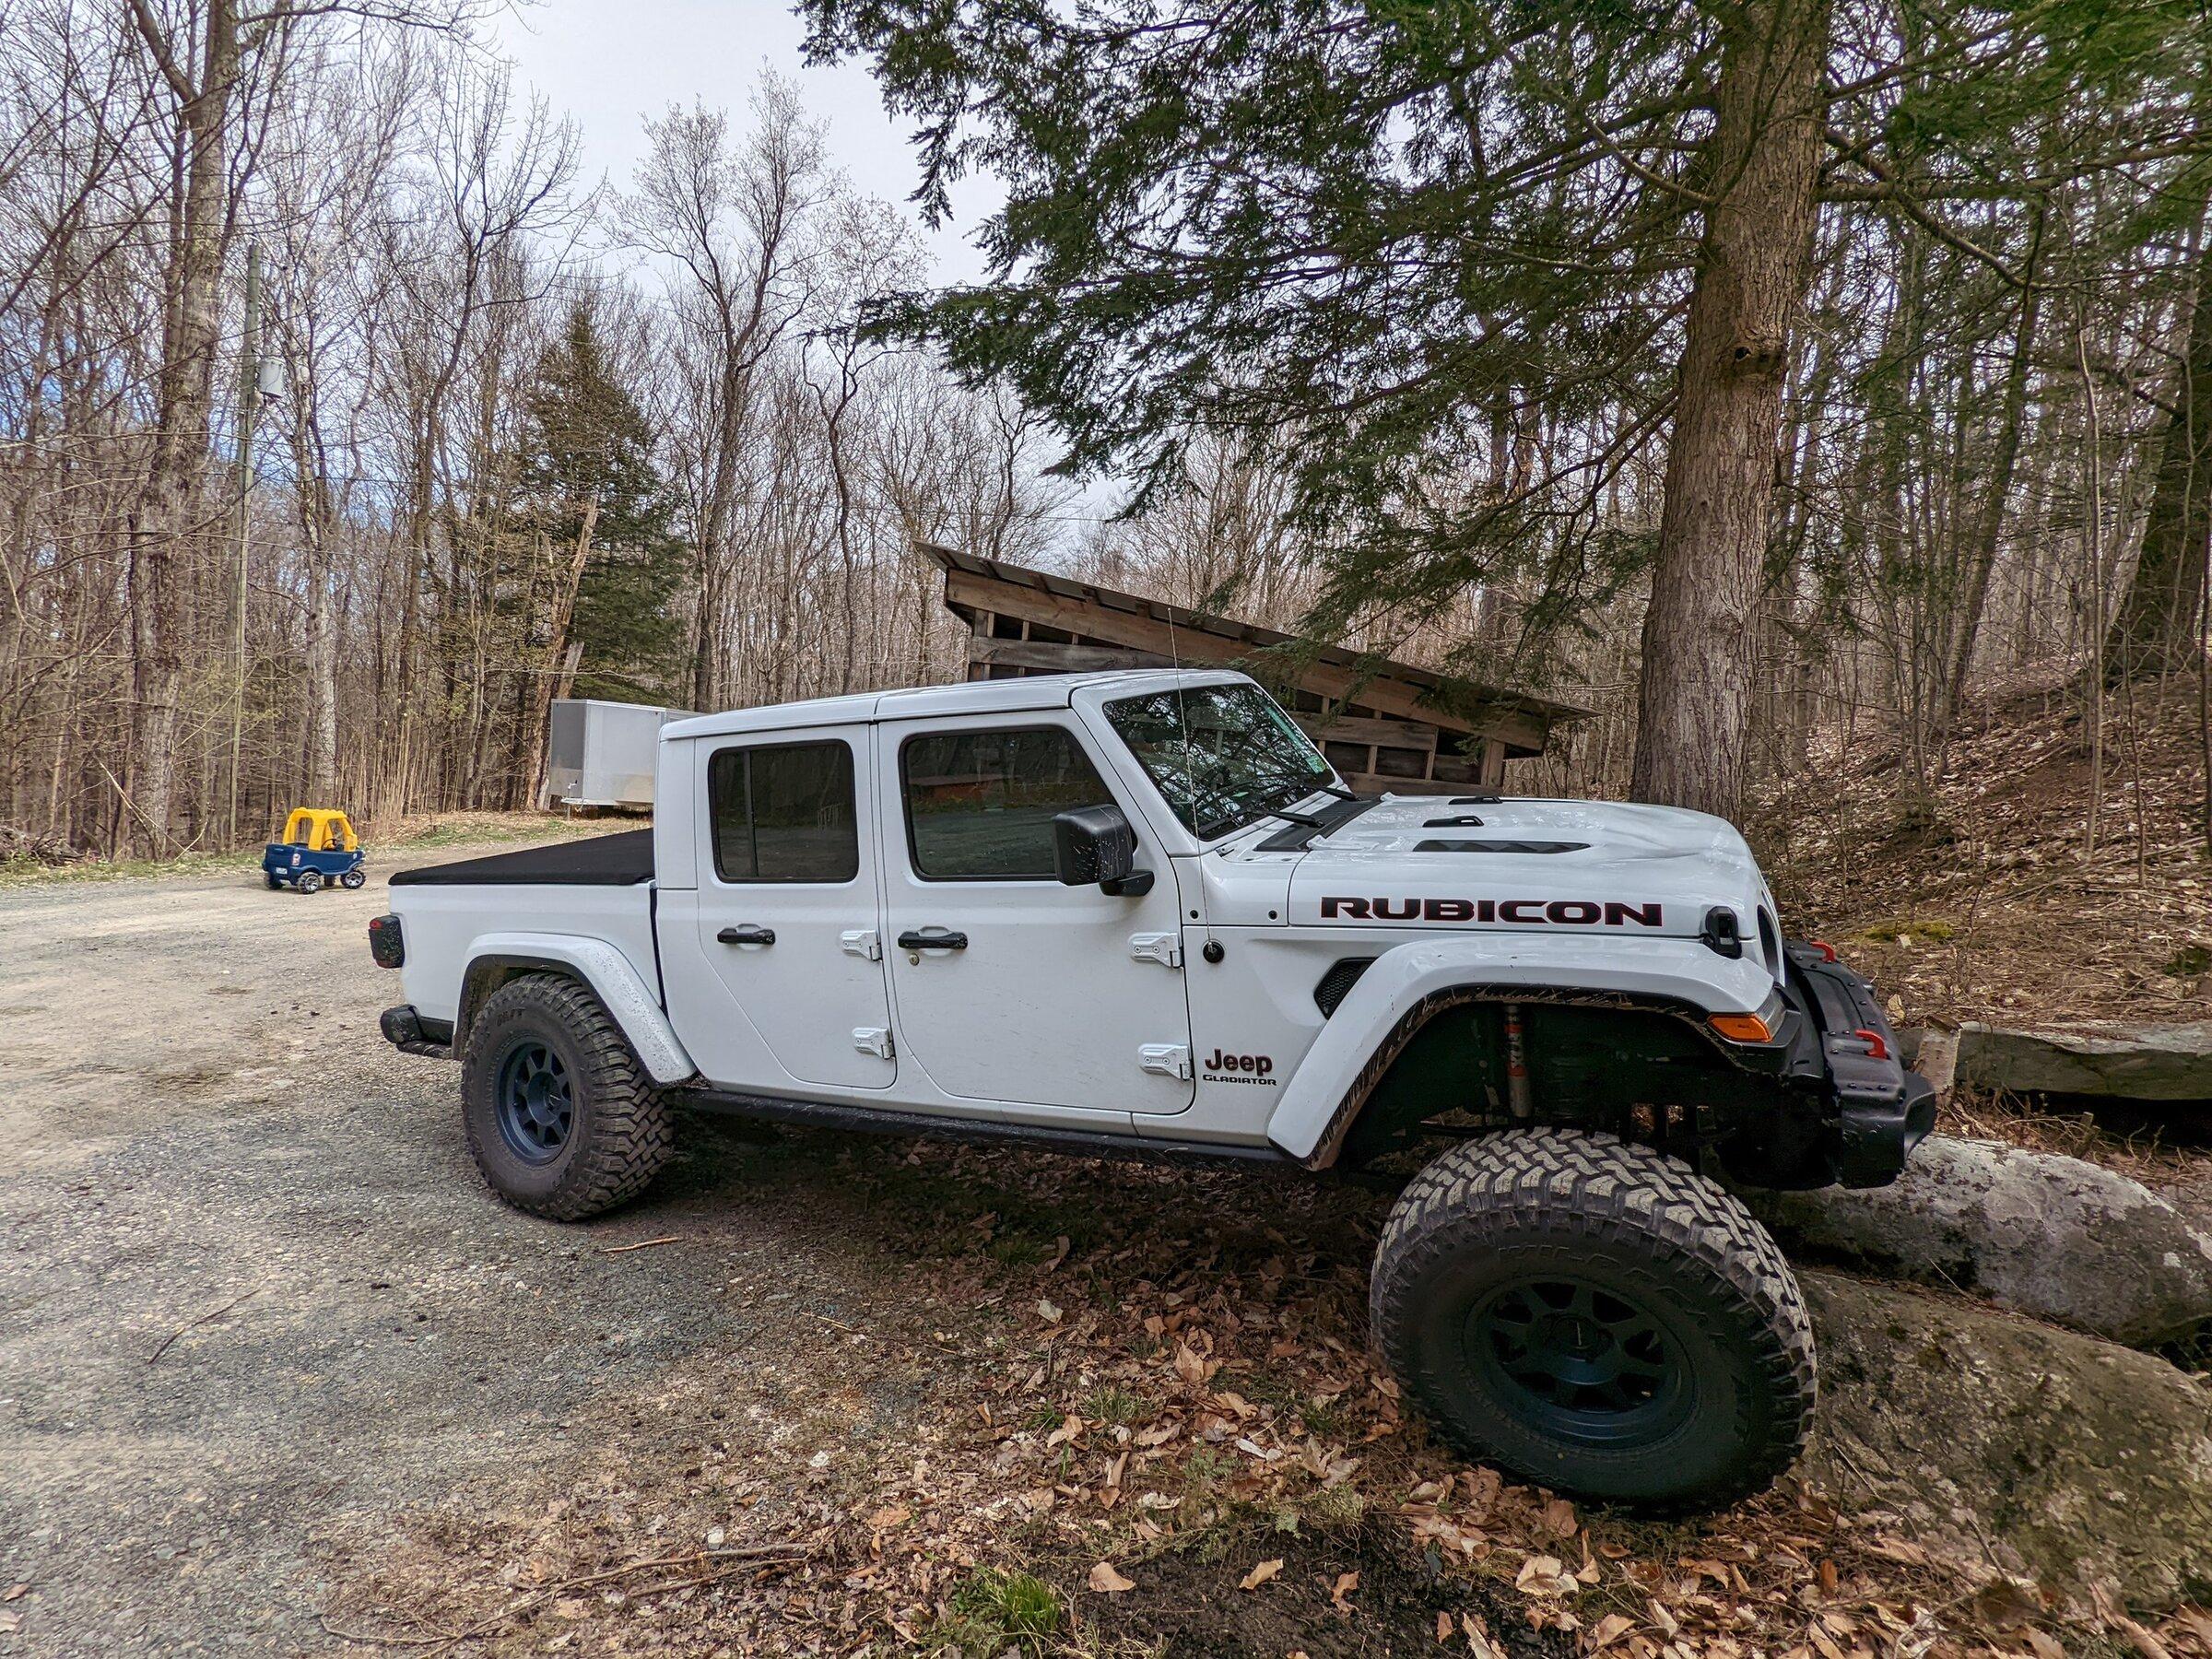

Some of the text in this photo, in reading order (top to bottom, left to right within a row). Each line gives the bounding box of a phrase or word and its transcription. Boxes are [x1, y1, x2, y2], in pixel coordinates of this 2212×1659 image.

[1320, 896, 1663, 927] RUBICON
[1205, 1048, 1273, 1077] Jeep
[1203, 1074, 1277, 1086] GLADIATOR
